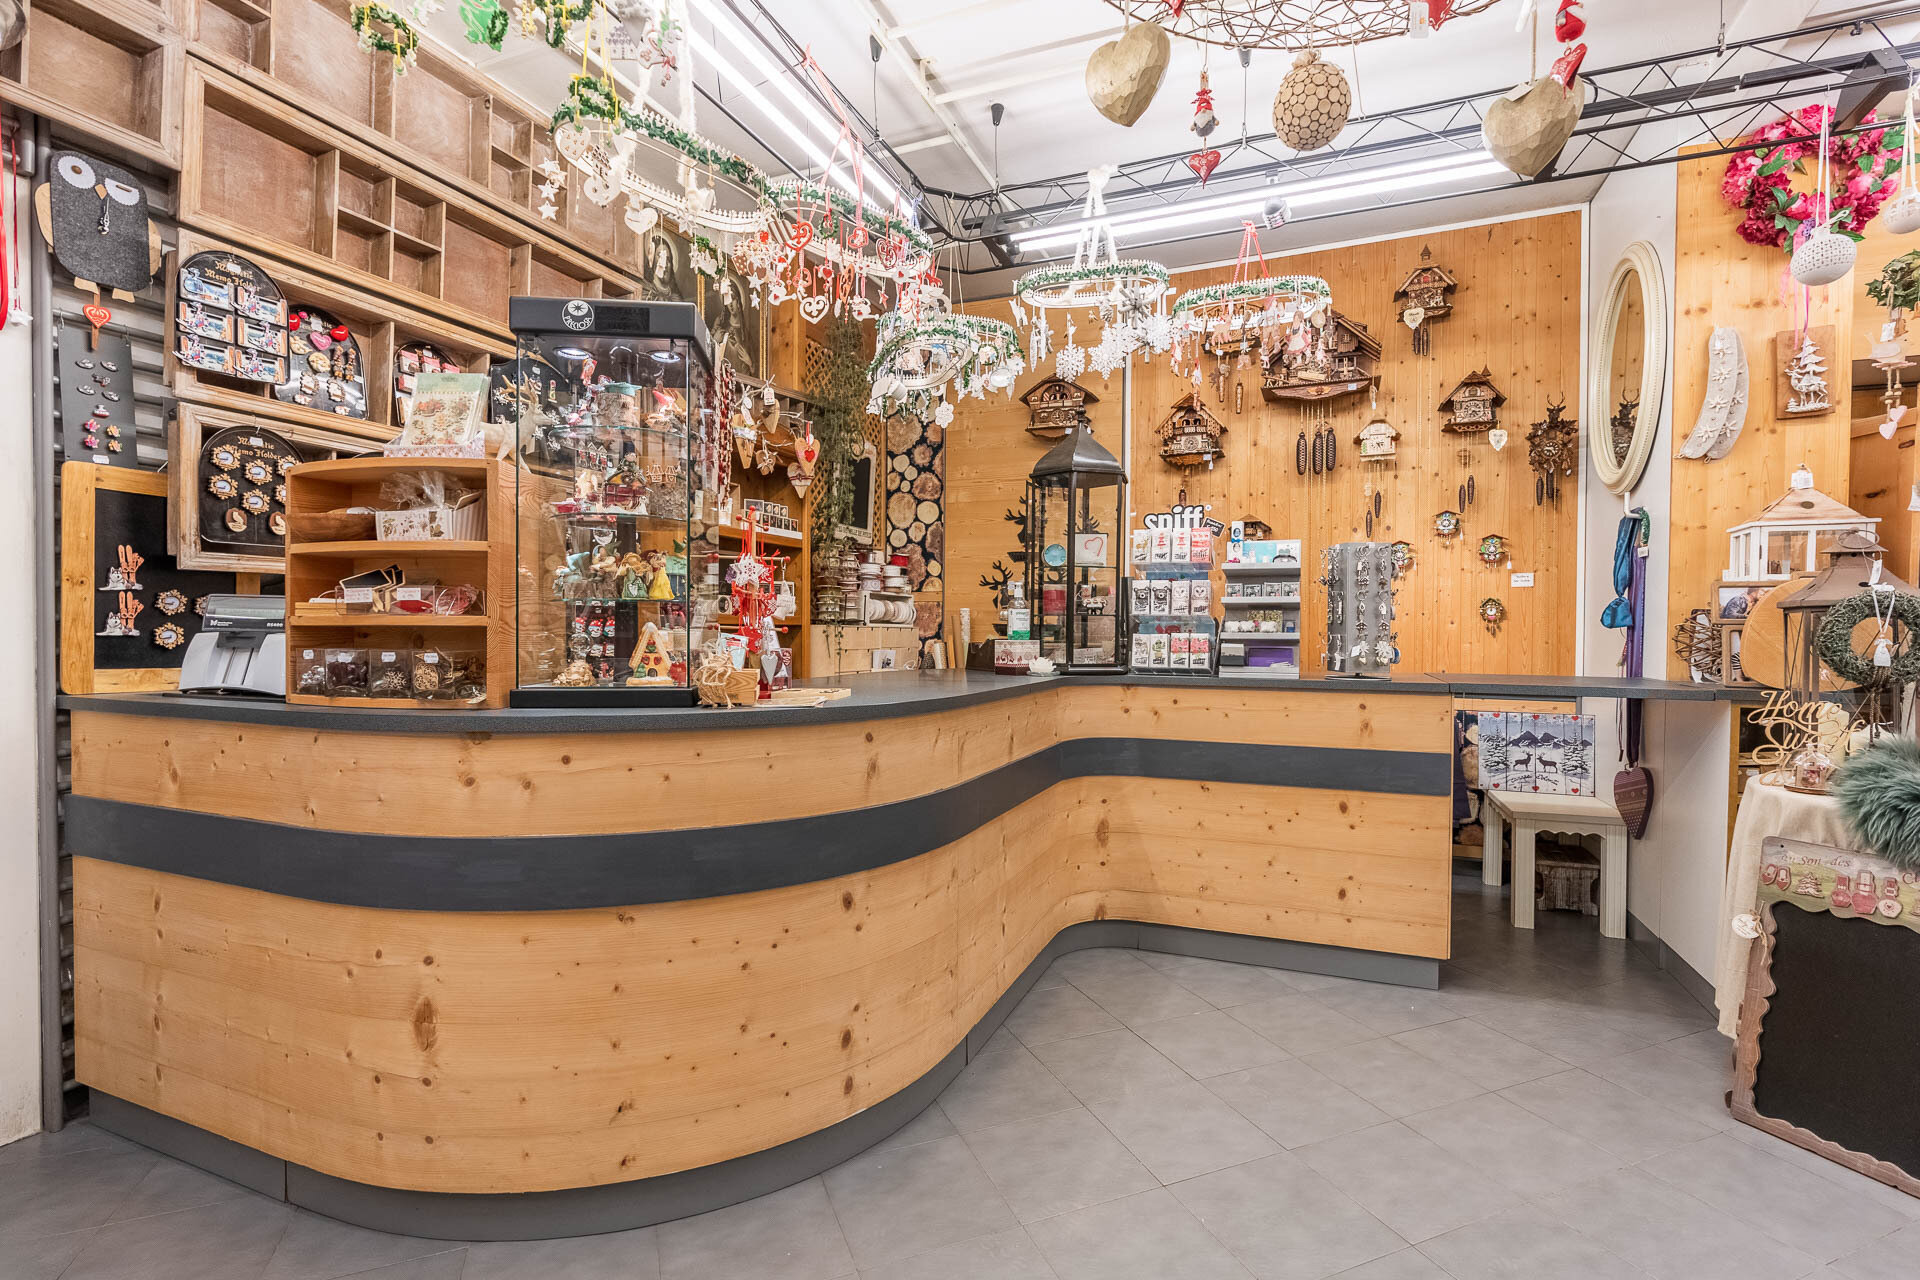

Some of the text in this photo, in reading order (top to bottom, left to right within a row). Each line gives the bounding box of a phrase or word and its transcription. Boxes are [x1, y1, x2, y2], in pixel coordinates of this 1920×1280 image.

[232, 276, 262, 292] Holdr
[564, 315, 592, 329] PRECIOSA
[1747, 690, 1843, 725] Home
[1830, 855, 1851, 867] des
